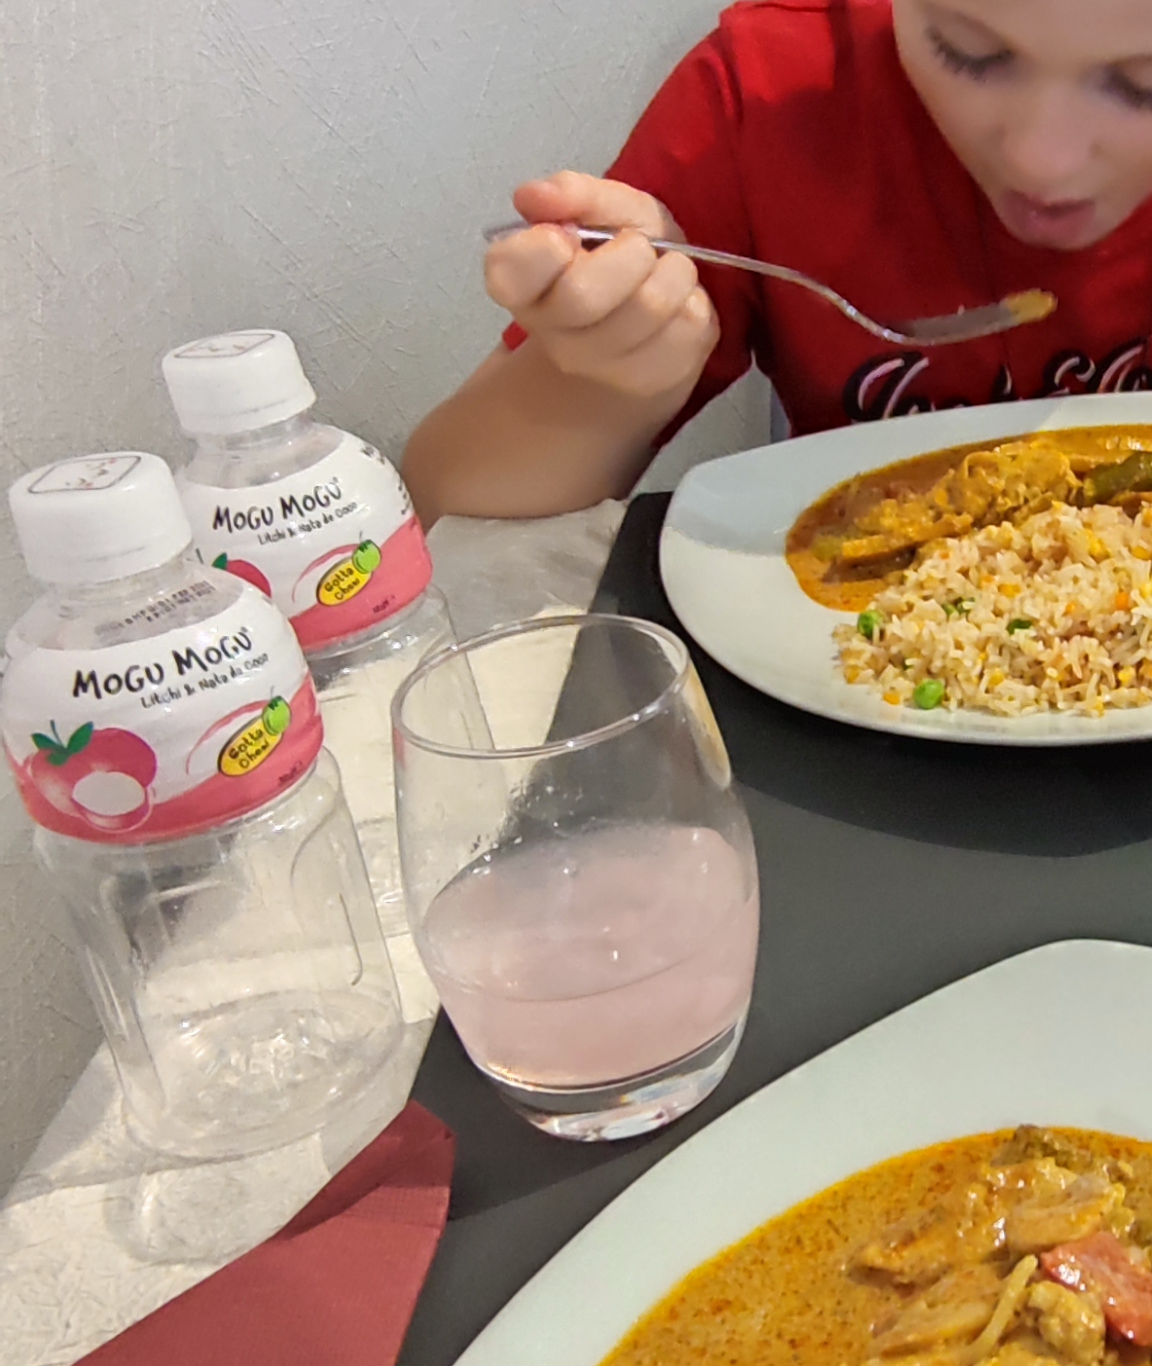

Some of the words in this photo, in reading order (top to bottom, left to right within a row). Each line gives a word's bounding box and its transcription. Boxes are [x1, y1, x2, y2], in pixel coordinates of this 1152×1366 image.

[212, 505, 274, 533] MOGU
[279, 481, 342, 520] MOGU
[257, 526, 287, 546] Litchi
[298, 518, 322, 533] Nata
[322, 512, 334, 525] de
[335, 501, 358, 518] Coco
[324, 567, 355, 592] Gotta
[334, 578, 361, 600] Chew
[72, 662, 165, 700] MOGU
[171, 630, 252, 677] MOGU
[140, 686, 182, 709] Litchi
[183, 683, 197, 696] &
[198, 672, 228, 691] Nata
[230, 664, 243, 678] de
[244, 652, 269, 669] Coco
[228, 729, 264, 759] Gotta
[238, 738, 270, 769] Chew
